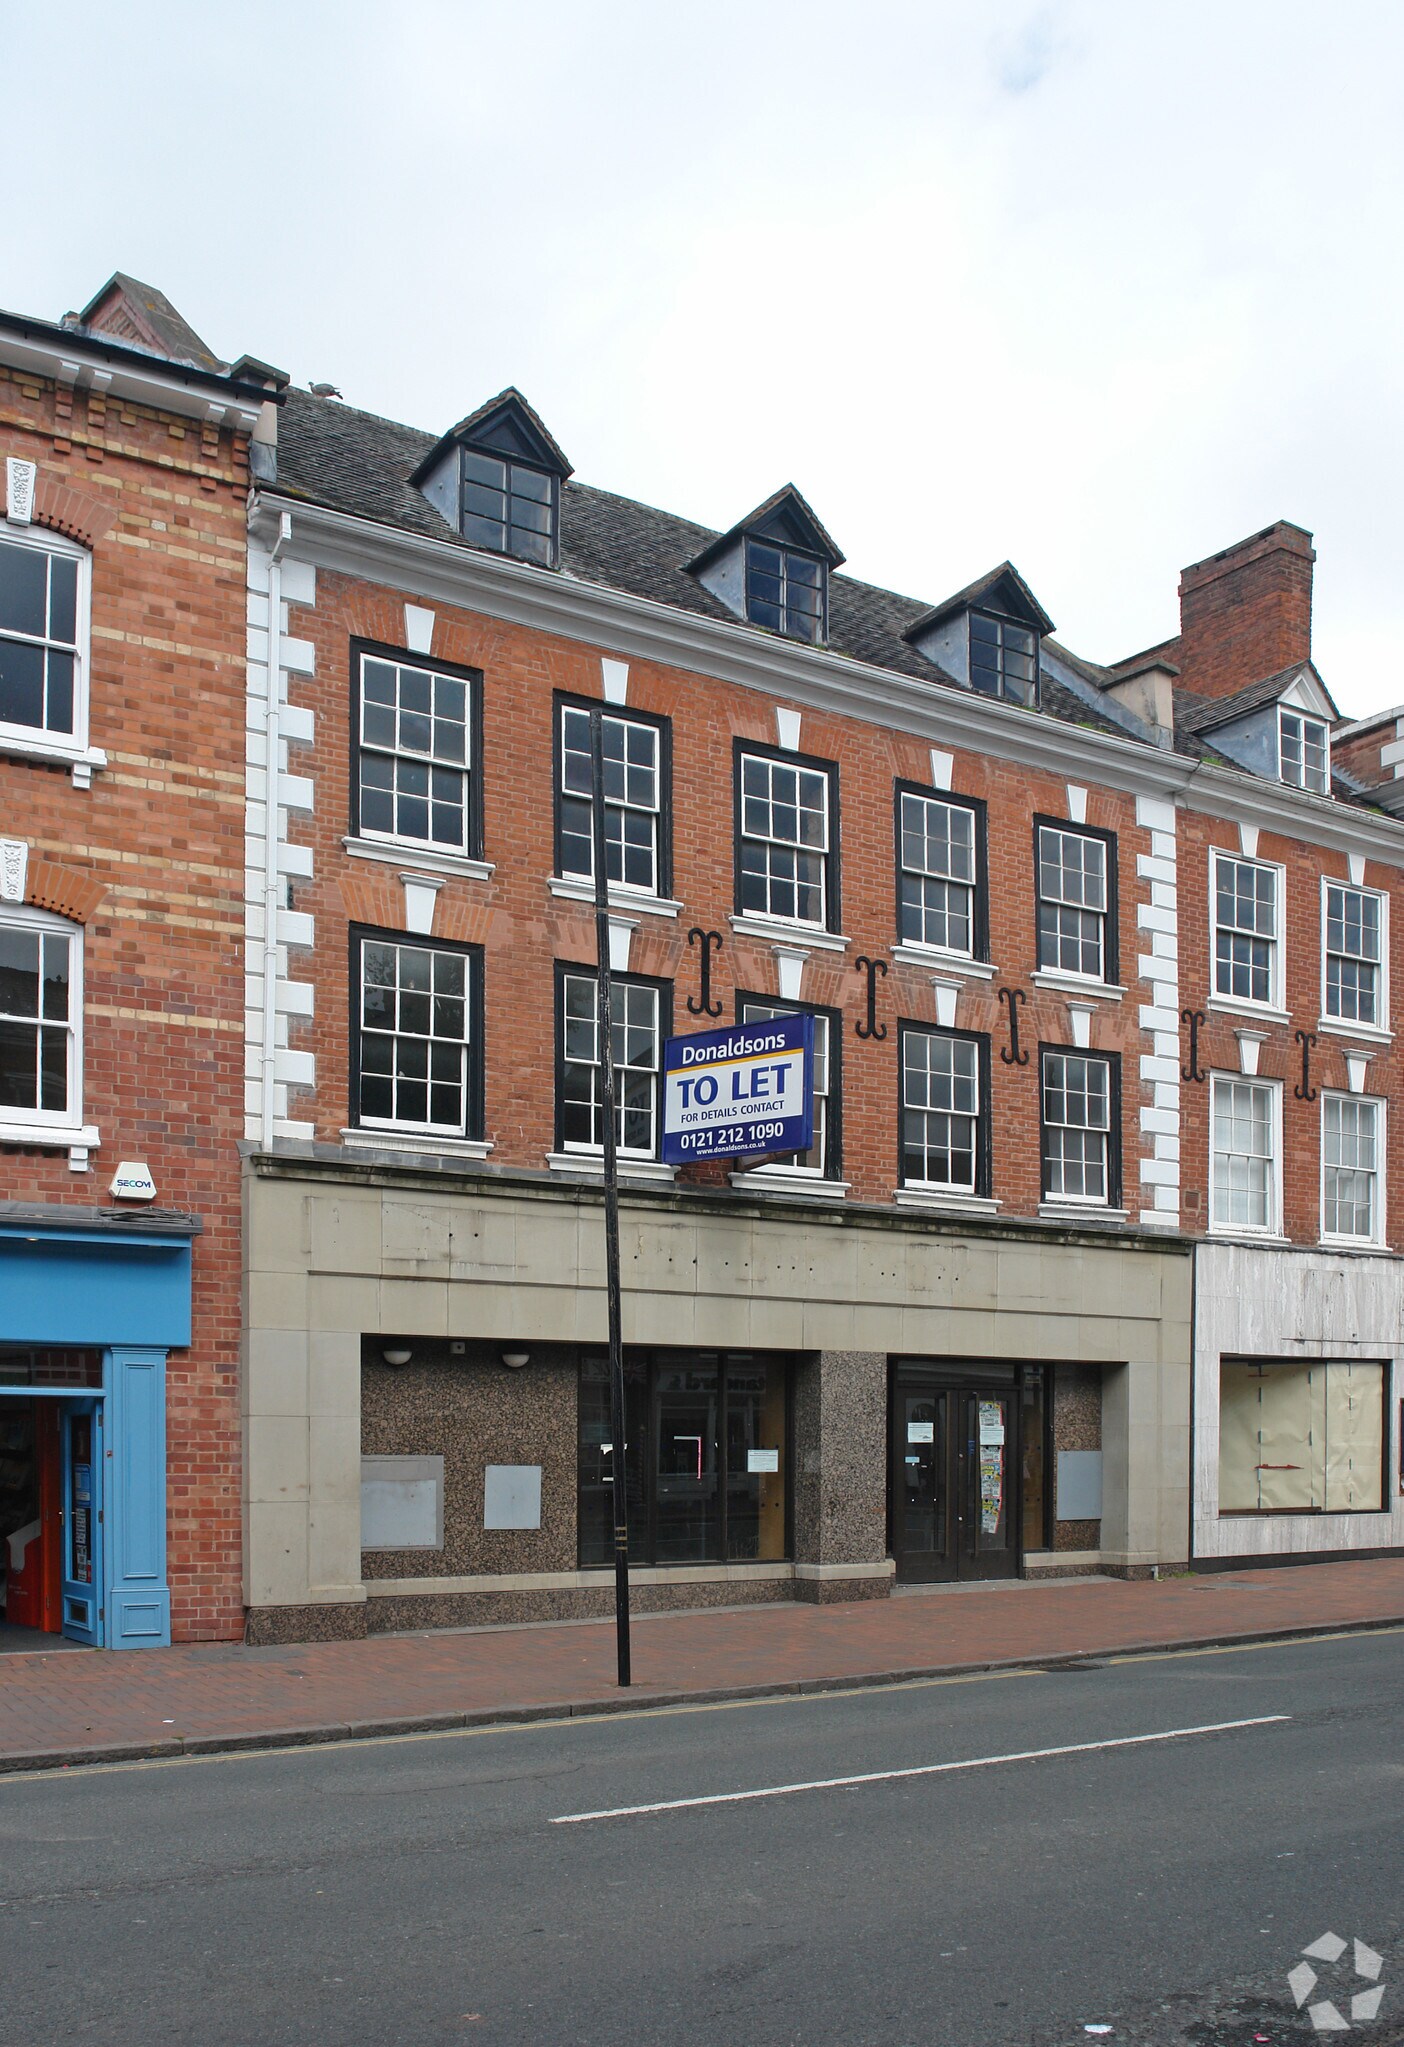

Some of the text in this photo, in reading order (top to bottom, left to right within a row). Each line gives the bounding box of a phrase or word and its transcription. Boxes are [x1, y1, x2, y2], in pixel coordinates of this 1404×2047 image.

[682, 1033, 786, 1065] Donaldsons
[676, 1063, 792, 1109] TO LET
[680, 1100, 785, 1124] FOR DETAILS CONTACT
[680, 1122, 784, 1149] 0121 212 1090
[696, 1140, 766, 1156] www.donaldsons.co.uk
[117, 1179, 151, 1188] SECOM
